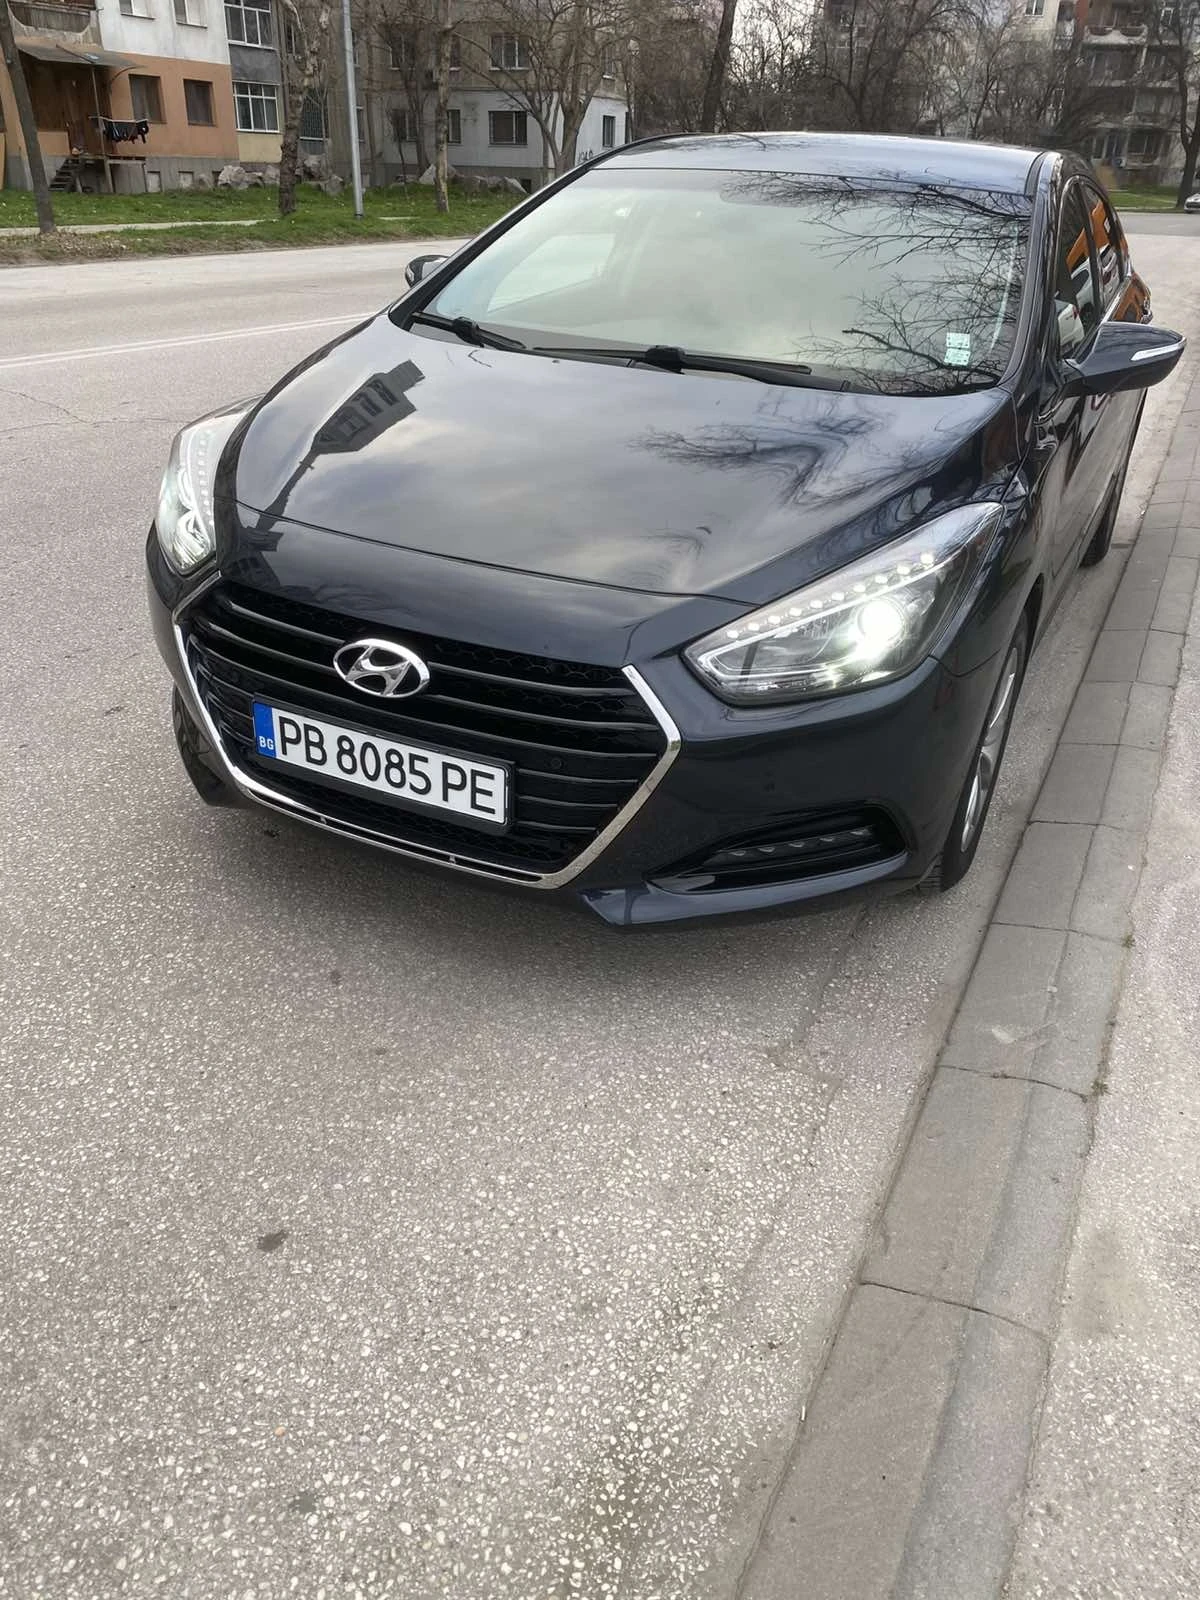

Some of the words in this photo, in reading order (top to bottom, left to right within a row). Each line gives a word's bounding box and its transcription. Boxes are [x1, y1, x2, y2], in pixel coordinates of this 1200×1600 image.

[259, 735, 275, 750] BG
[279, 716, 327, 766] PB
[336, 735, 431, 795] 8085
[442, 761, 495, 815] PE
